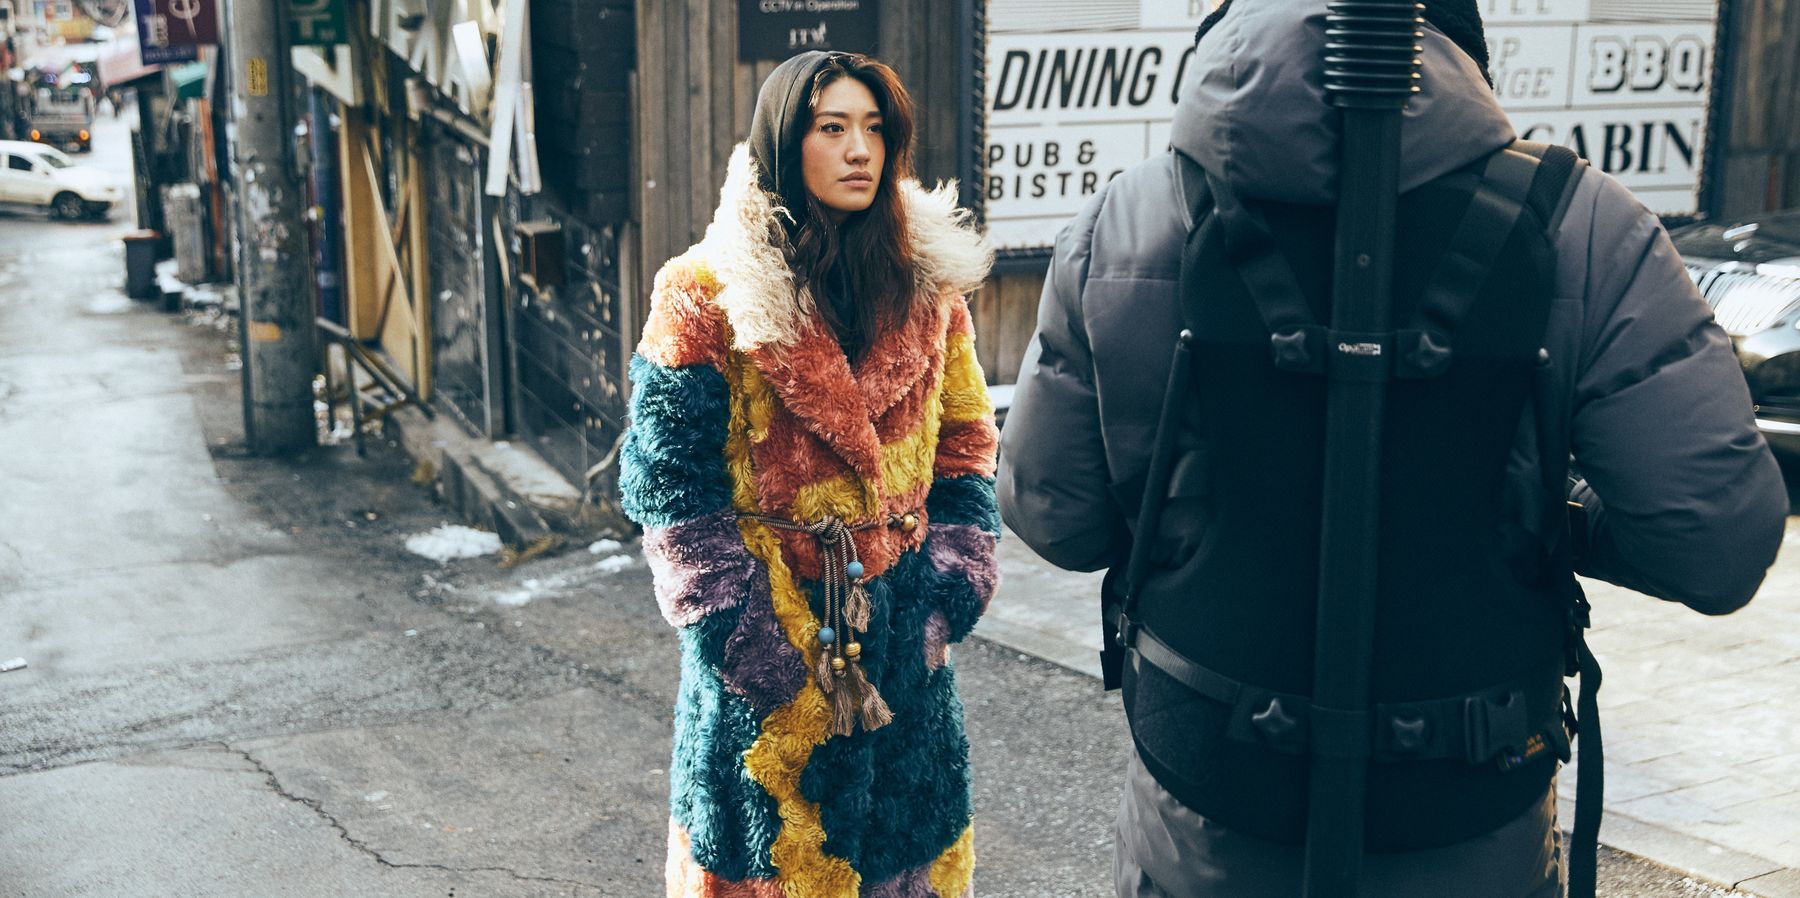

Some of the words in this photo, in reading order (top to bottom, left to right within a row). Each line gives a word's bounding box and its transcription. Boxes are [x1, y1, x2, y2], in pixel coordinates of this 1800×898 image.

[759, 0, 792, 13] CCTV
[805, 0, 860, 14] Operation
[993, 46, 1162, 111] DINING
[1589, 34, 1706, 93] BBQ
[988, 142, 1060, 168] PUB
[1077, 141, 1097, 165] &
